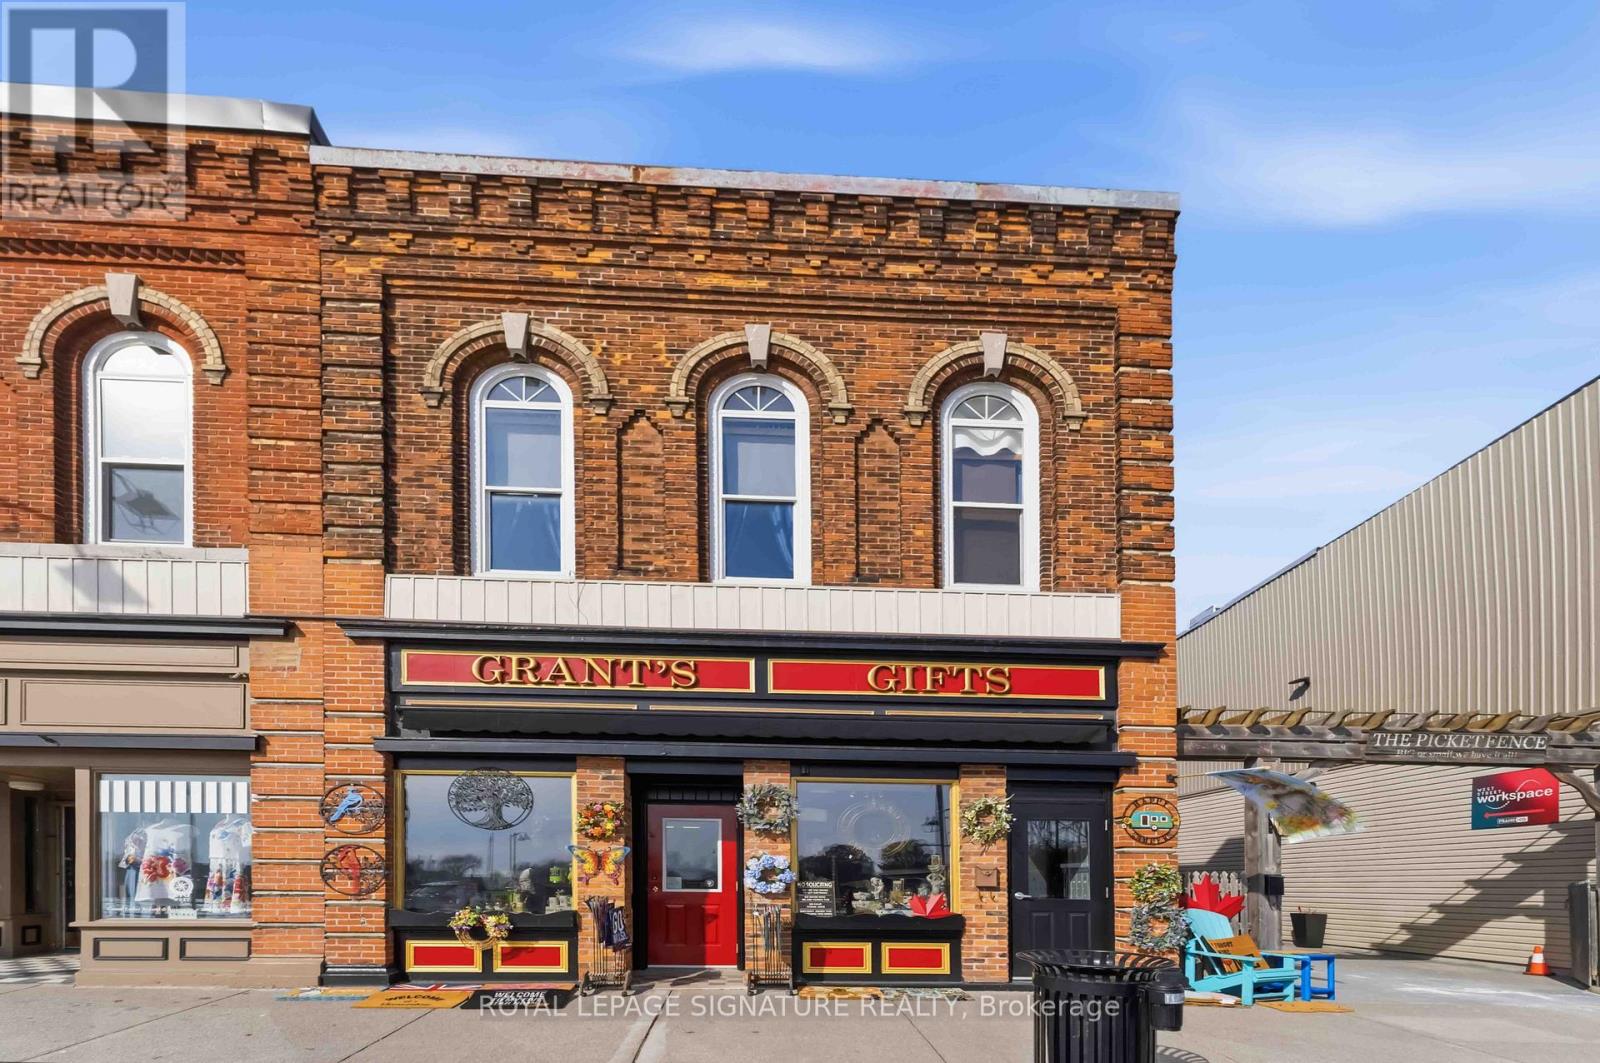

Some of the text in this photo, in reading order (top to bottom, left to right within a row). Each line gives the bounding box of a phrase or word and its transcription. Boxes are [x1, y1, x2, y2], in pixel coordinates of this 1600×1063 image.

[472, 655, 698, 688] GRANT'S
[867, 665, 1011, 694] GIFTS
[1373, 733, 1548, 750] THE PICKET FENCE
[1476, 787, 1553, 803] workspace
[612, 910, 625, 934] GO
